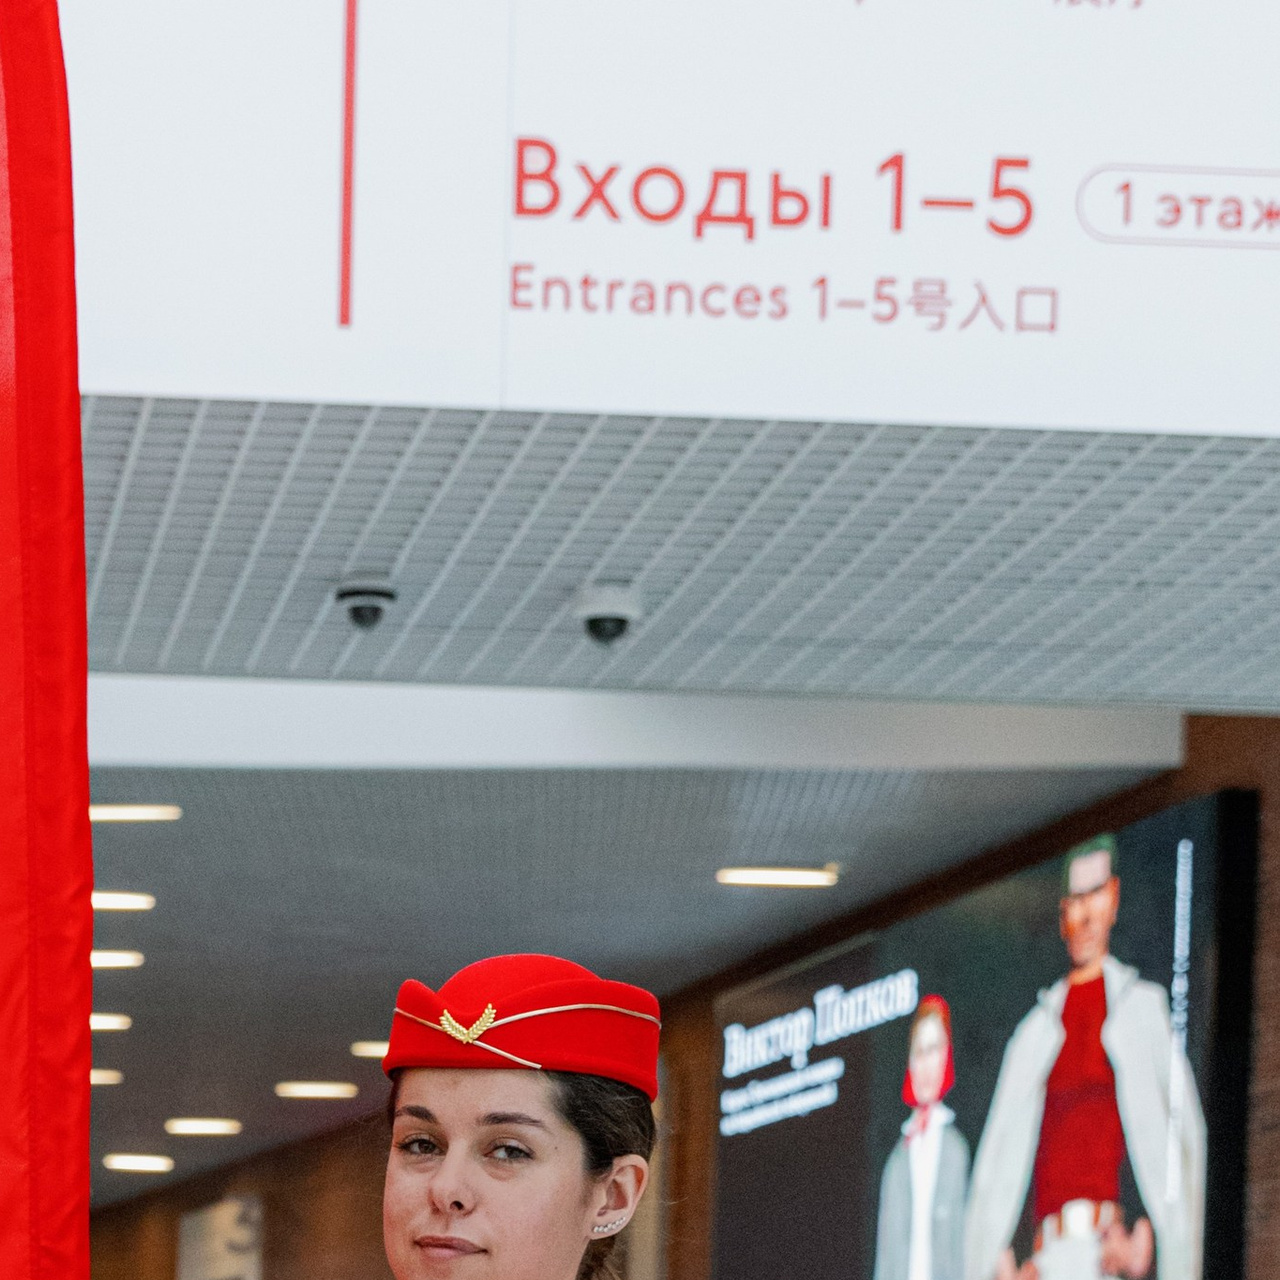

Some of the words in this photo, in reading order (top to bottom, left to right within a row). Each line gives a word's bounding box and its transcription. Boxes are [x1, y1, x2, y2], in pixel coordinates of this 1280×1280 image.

[512, 136, 833, 242] Входы
[1116, 181, 1133, 225] 1
[1157, 193, 1280, 232] этаж
[509, 263, 789, 320] Entrances
